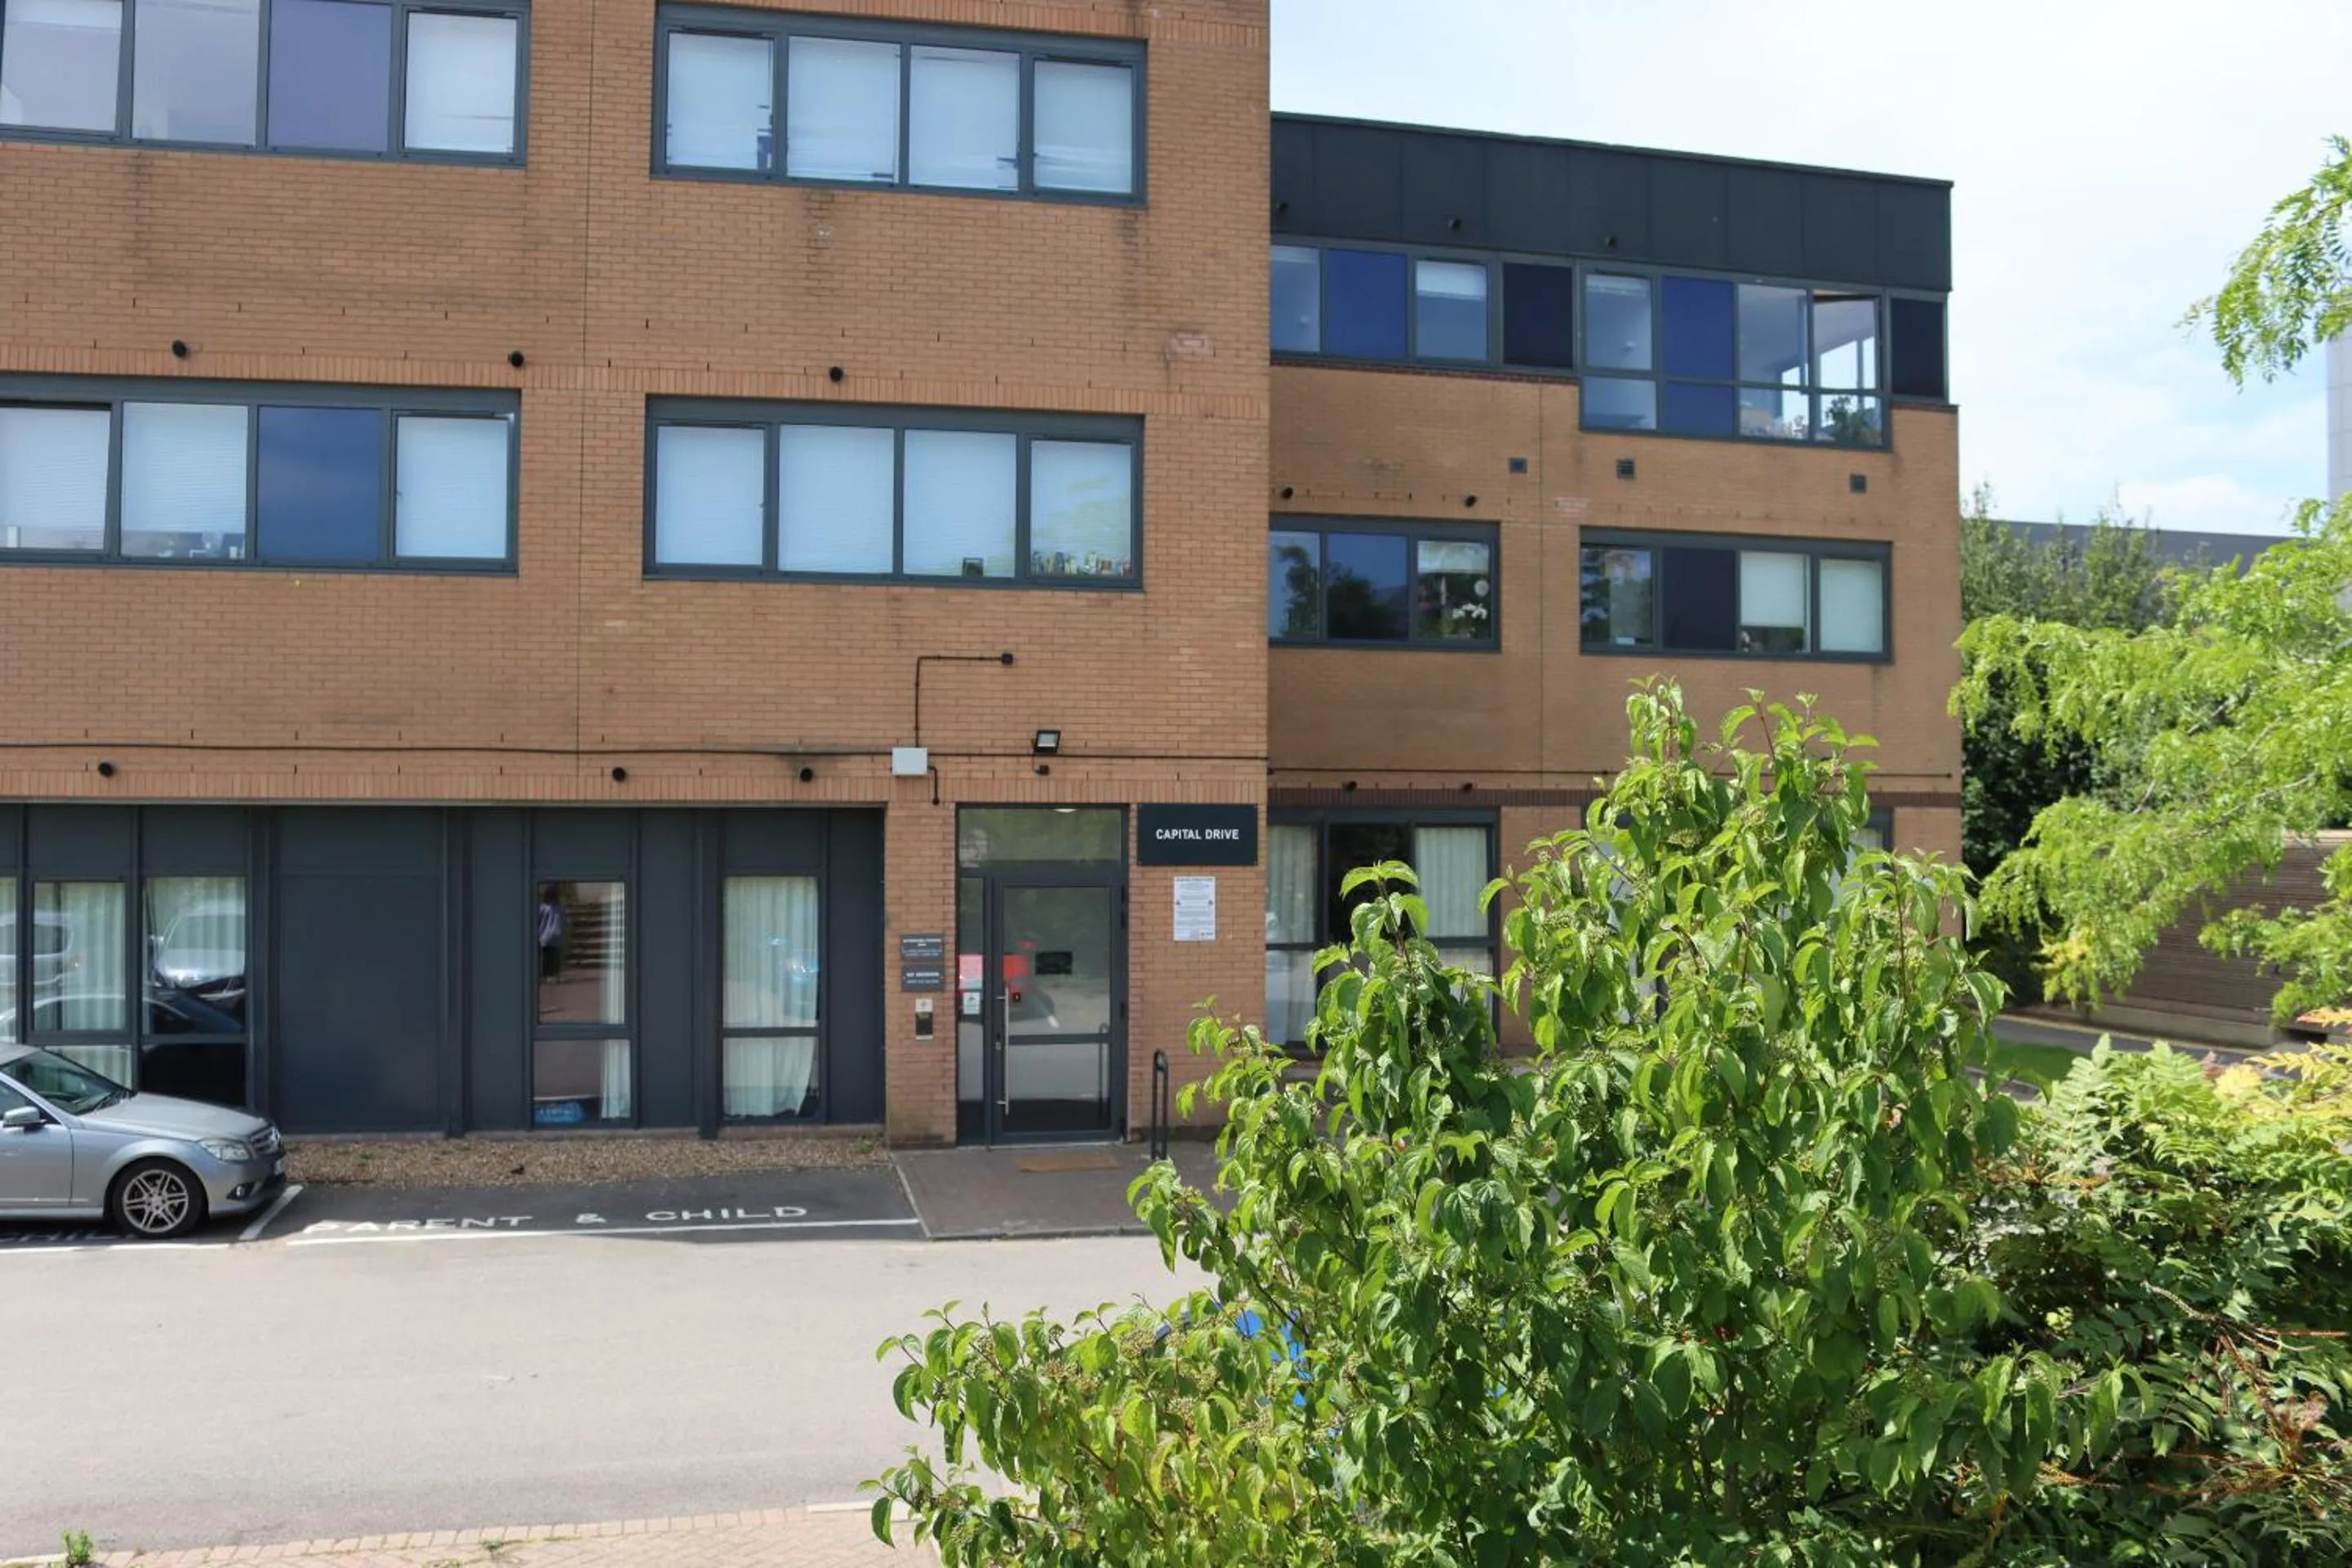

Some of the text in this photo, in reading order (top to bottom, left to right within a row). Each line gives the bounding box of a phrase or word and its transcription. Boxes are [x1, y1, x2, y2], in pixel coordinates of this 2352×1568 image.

[1155, 828, 1239, 840] CAPITAL DRIVE
[302, 1206, 807, 1234] PARENT & CHILD
